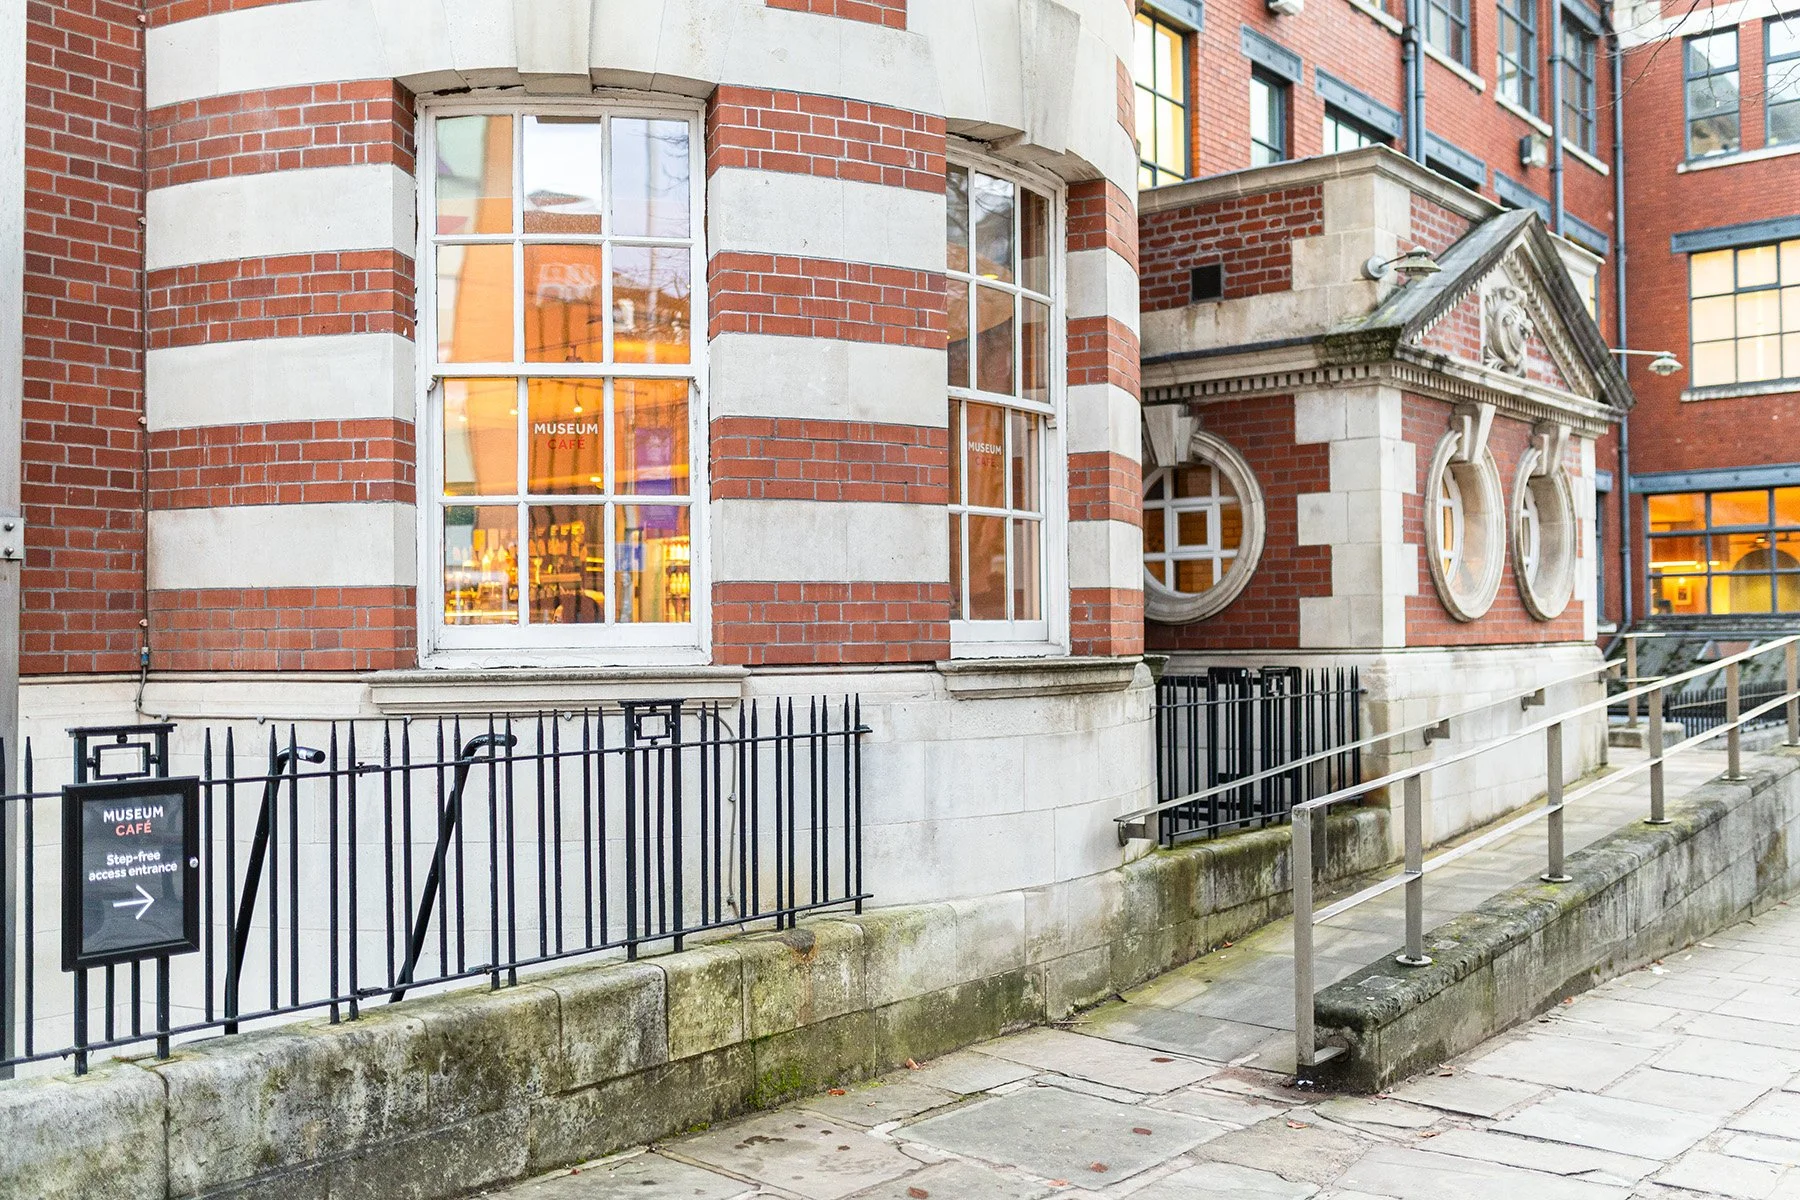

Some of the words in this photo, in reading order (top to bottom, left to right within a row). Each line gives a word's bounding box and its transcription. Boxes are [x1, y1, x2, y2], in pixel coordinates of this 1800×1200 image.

[534, 423, 598, 435] MUSEUM
[547, 436, 585, 450] CAFÉ
[968, 441, 1002, 456] MUSEUM
[103, 806, 164, 823] MUSEUM
[115, 820, 152, 836] CAFÉ
[106, 851, 161, 867] Step-free
[88, 867, 127, 882] access
[128, 861, 178, 877] entrance
